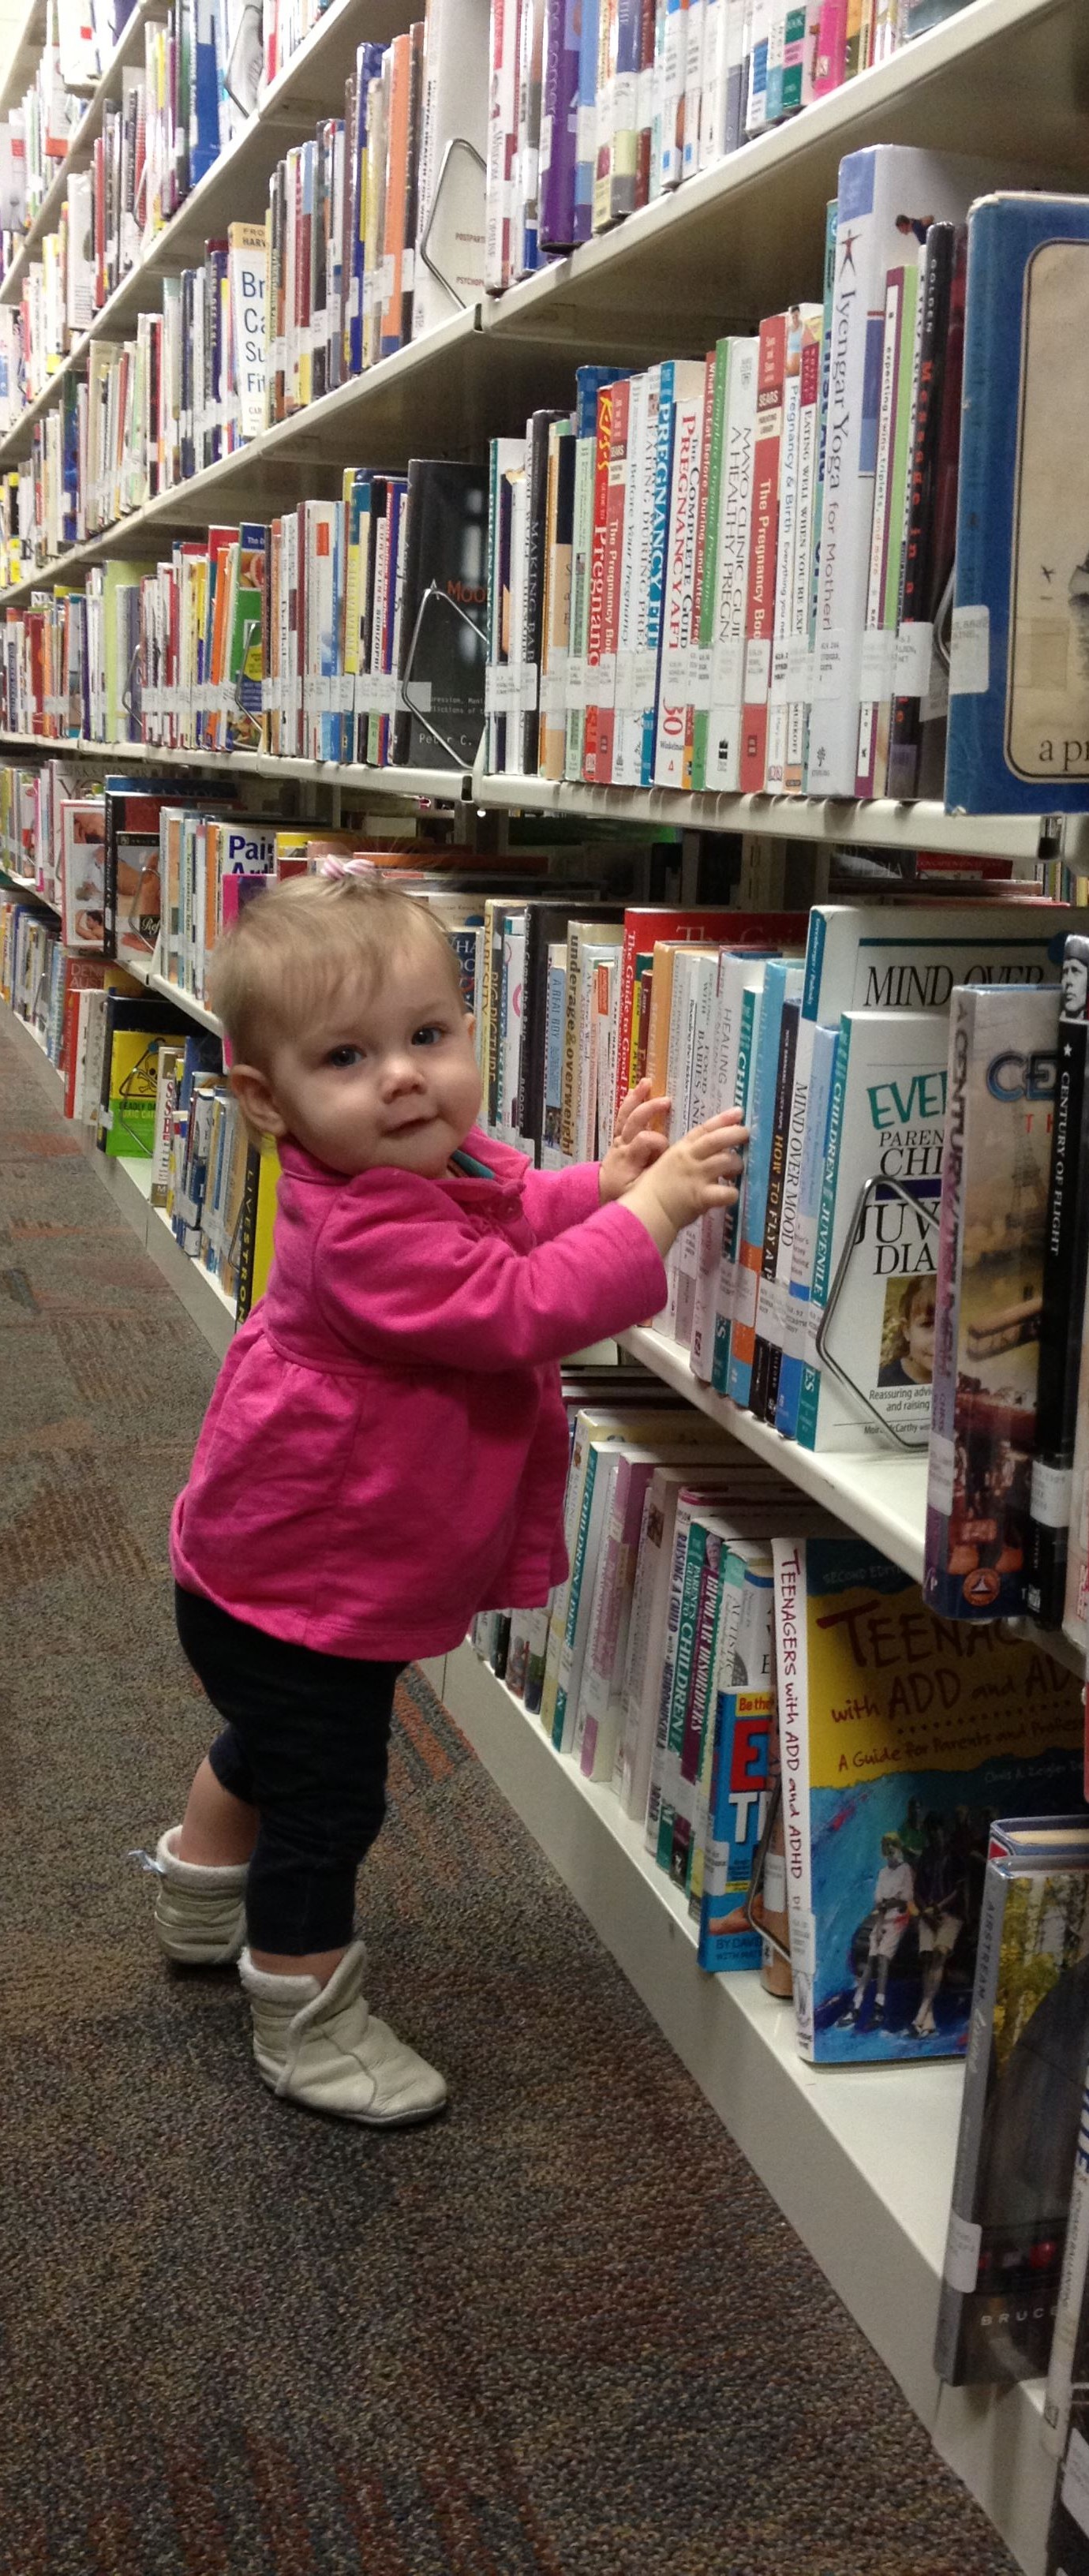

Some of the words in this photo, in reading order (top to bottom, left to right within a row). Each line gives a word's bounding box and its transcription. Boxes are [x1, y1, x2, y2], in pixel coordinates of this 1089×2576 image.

[832, 288, 855, 410] Iyengar
[707, 361, 717, 395] What
[881, 346, 892, 412] expecting
[705, 417, 713, 439] Eat
[706, 399, 714, 417] to
[785, 384, 799, 470] Pregnancy
[731, 426, 742, 444] A
[802, 410, 814, 462] EATING
[829, 412, 850, 489] Yoga
[701, 442, 711, 492] Before,
[740, 427, 752, 498] MAYO
[787, 476, 795, 489] &
[800, 466, 810, 500] WELL
[648, 402, 671, 592] PREGNANCY
[672, 415, 696, 593] PREGNANCY
[724, 451, 741, 555] HEALTHY
[759, 477, 772, 511] The
[784, 494, 795, 534] Birth
[829, 502, 839, 534] for
[609, 519, 619, 545] The
[683, 467, 700, 586] COMPLETE
[698, 496, 709, 545] During,
[735, 505, 748, 582] CLINIC
[799, 506, 809, 546] WHEN
[528, 521, 540, 612] MAKING
[696, 549, 705, 574] and
[752, 515, 770, 604] Pregnancy
[780, 540, 791, 597] Everything
[605, 550, 619, 624] Pregnancy
[694, 577, 704, 611] After
[459, 734, 473, 746] C.
[662, 696, 683, 736] 30
[1038, 739, 1053, 762] a
[627, 930, 636, 962] The
[623, 964, 634, 1014] Guide
[863, 964, 954, 1007] MIND
[623, 1017, 631, 1033] to
[718, 1008, 732, 1084] HEALING
[621, 1037, 632, 1082] Good
[694, 1029, 705, 1088] BABIES
[789, 1082, 809, 1125] MIND
[1055, 1071, 1071, 1158] CENTURY
[772, 1134, 784, 1174] HOW
[824, 1082, 843, 1183] CHILDREN
[785, 1129, 803, 1186] OVER
[1053, 1161, 1065, 1186] OF
[769, 1181, 780, 1204] TO
[765, 1210, 779, 1245] FLY
[780, 1189, 799, 1248] MOOD
[1050, 1190, 1064, 1257] FLIGHT
[812, 1202, 833, 1297] JUVENILE
[869, 1386, 913, 1401] Reassuring
[885, 1400, 904, 1412] and
[903, 1399, 930, 1413] raising
[573, 1492, 590, 1585] CHILDREN
[672, 1532, 688, 1582] RAISING
[668, 1597, 681, 1633] CHILD
[702, 1575, 719, 1645] BIPOLAR
[780, 1548, 801, 1676] TEENAGERS
[671, 1622, 694, 1732] CHILDREN
[690, 1645, 711, 1735] DISORDERS
[831, 1698, 881, 1724] with
[888, 1667, 961, 1721] ADD
[739, 1697, 753, 1712] Be
[784, 1682, 799, 1725] with
[784, 1731, 800, 1772] ADD
[837, 1754, 848, 1772] A
[852, 1747, 901, 1768] Guide
[908, 1741, 928, 1757] for
[788, 1777, 800, 1818] and
[788, 1824, 803, 1880] ADHD
[715, 1938, 731, 1950] BY
[977, 1900, 996, 2000] AIRSTREAM
